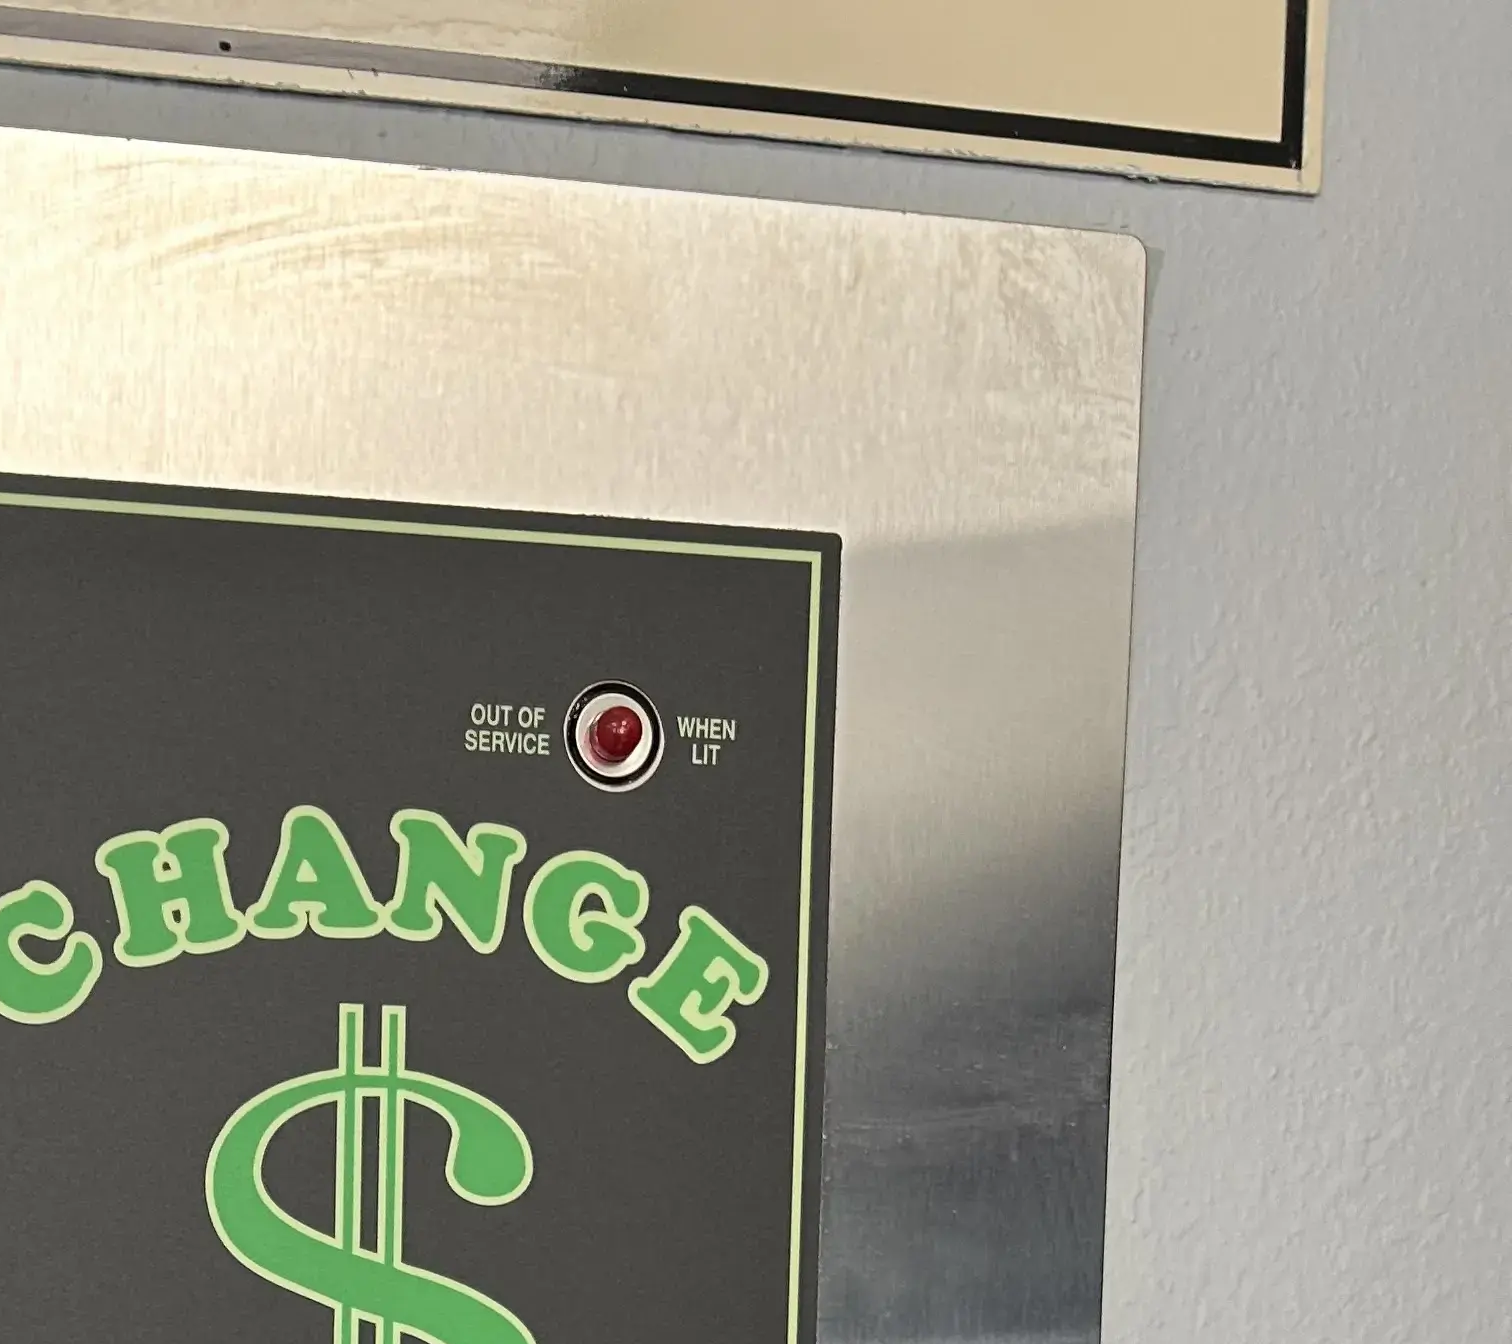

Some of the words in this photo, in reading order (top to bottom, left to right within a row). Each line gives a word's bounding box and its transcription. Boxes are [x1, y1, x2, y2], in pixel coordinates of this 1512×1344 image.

[470, 703, 513, 727] OUT
[518, 706, 545, 729] OF
[677, 716, 737, 741] WHEN
[464, 730, 550, 756] SERVICE
[691, 744, 721, 766] LIT
